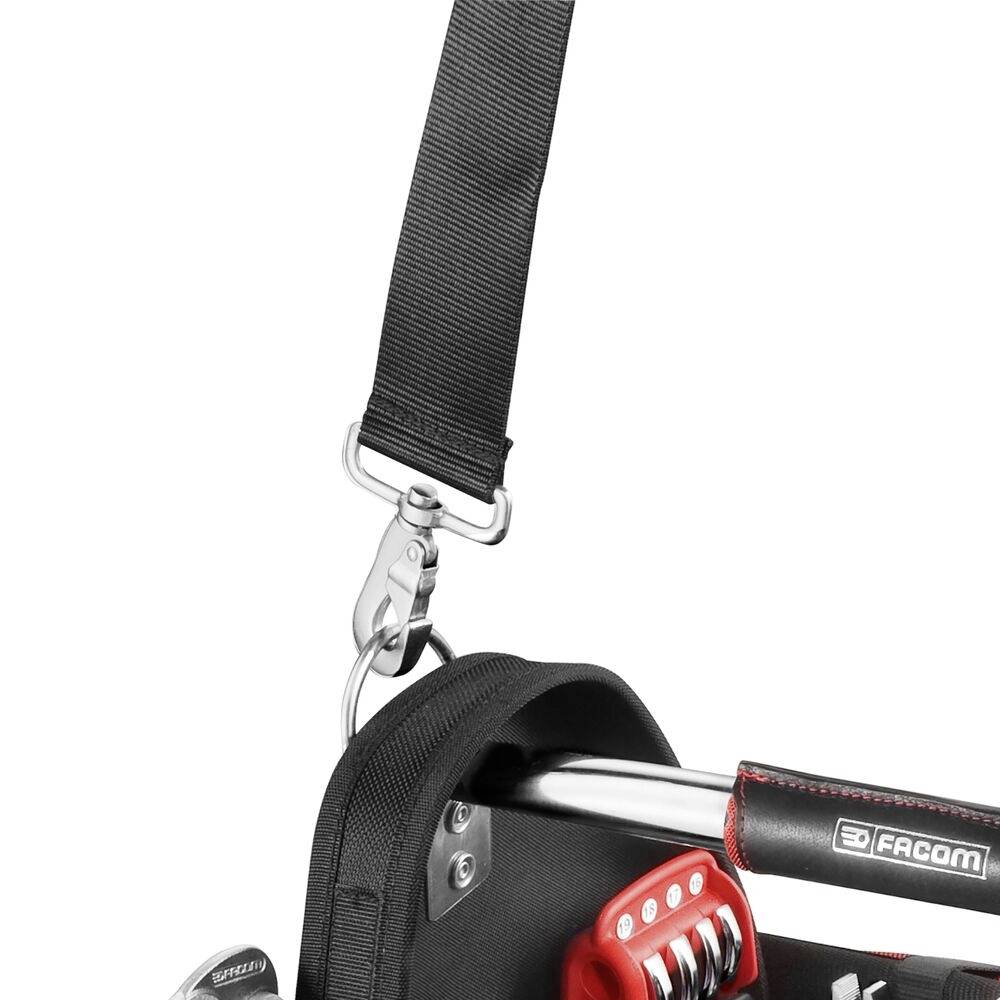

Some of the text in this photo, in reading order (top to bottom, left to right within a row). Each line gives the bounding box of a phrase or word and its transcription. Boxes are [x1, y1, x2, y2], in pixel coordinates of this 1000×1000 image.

[876, 833, 982, 872] FACOM
[618, 876, 702, 936] 19 18 17 16
